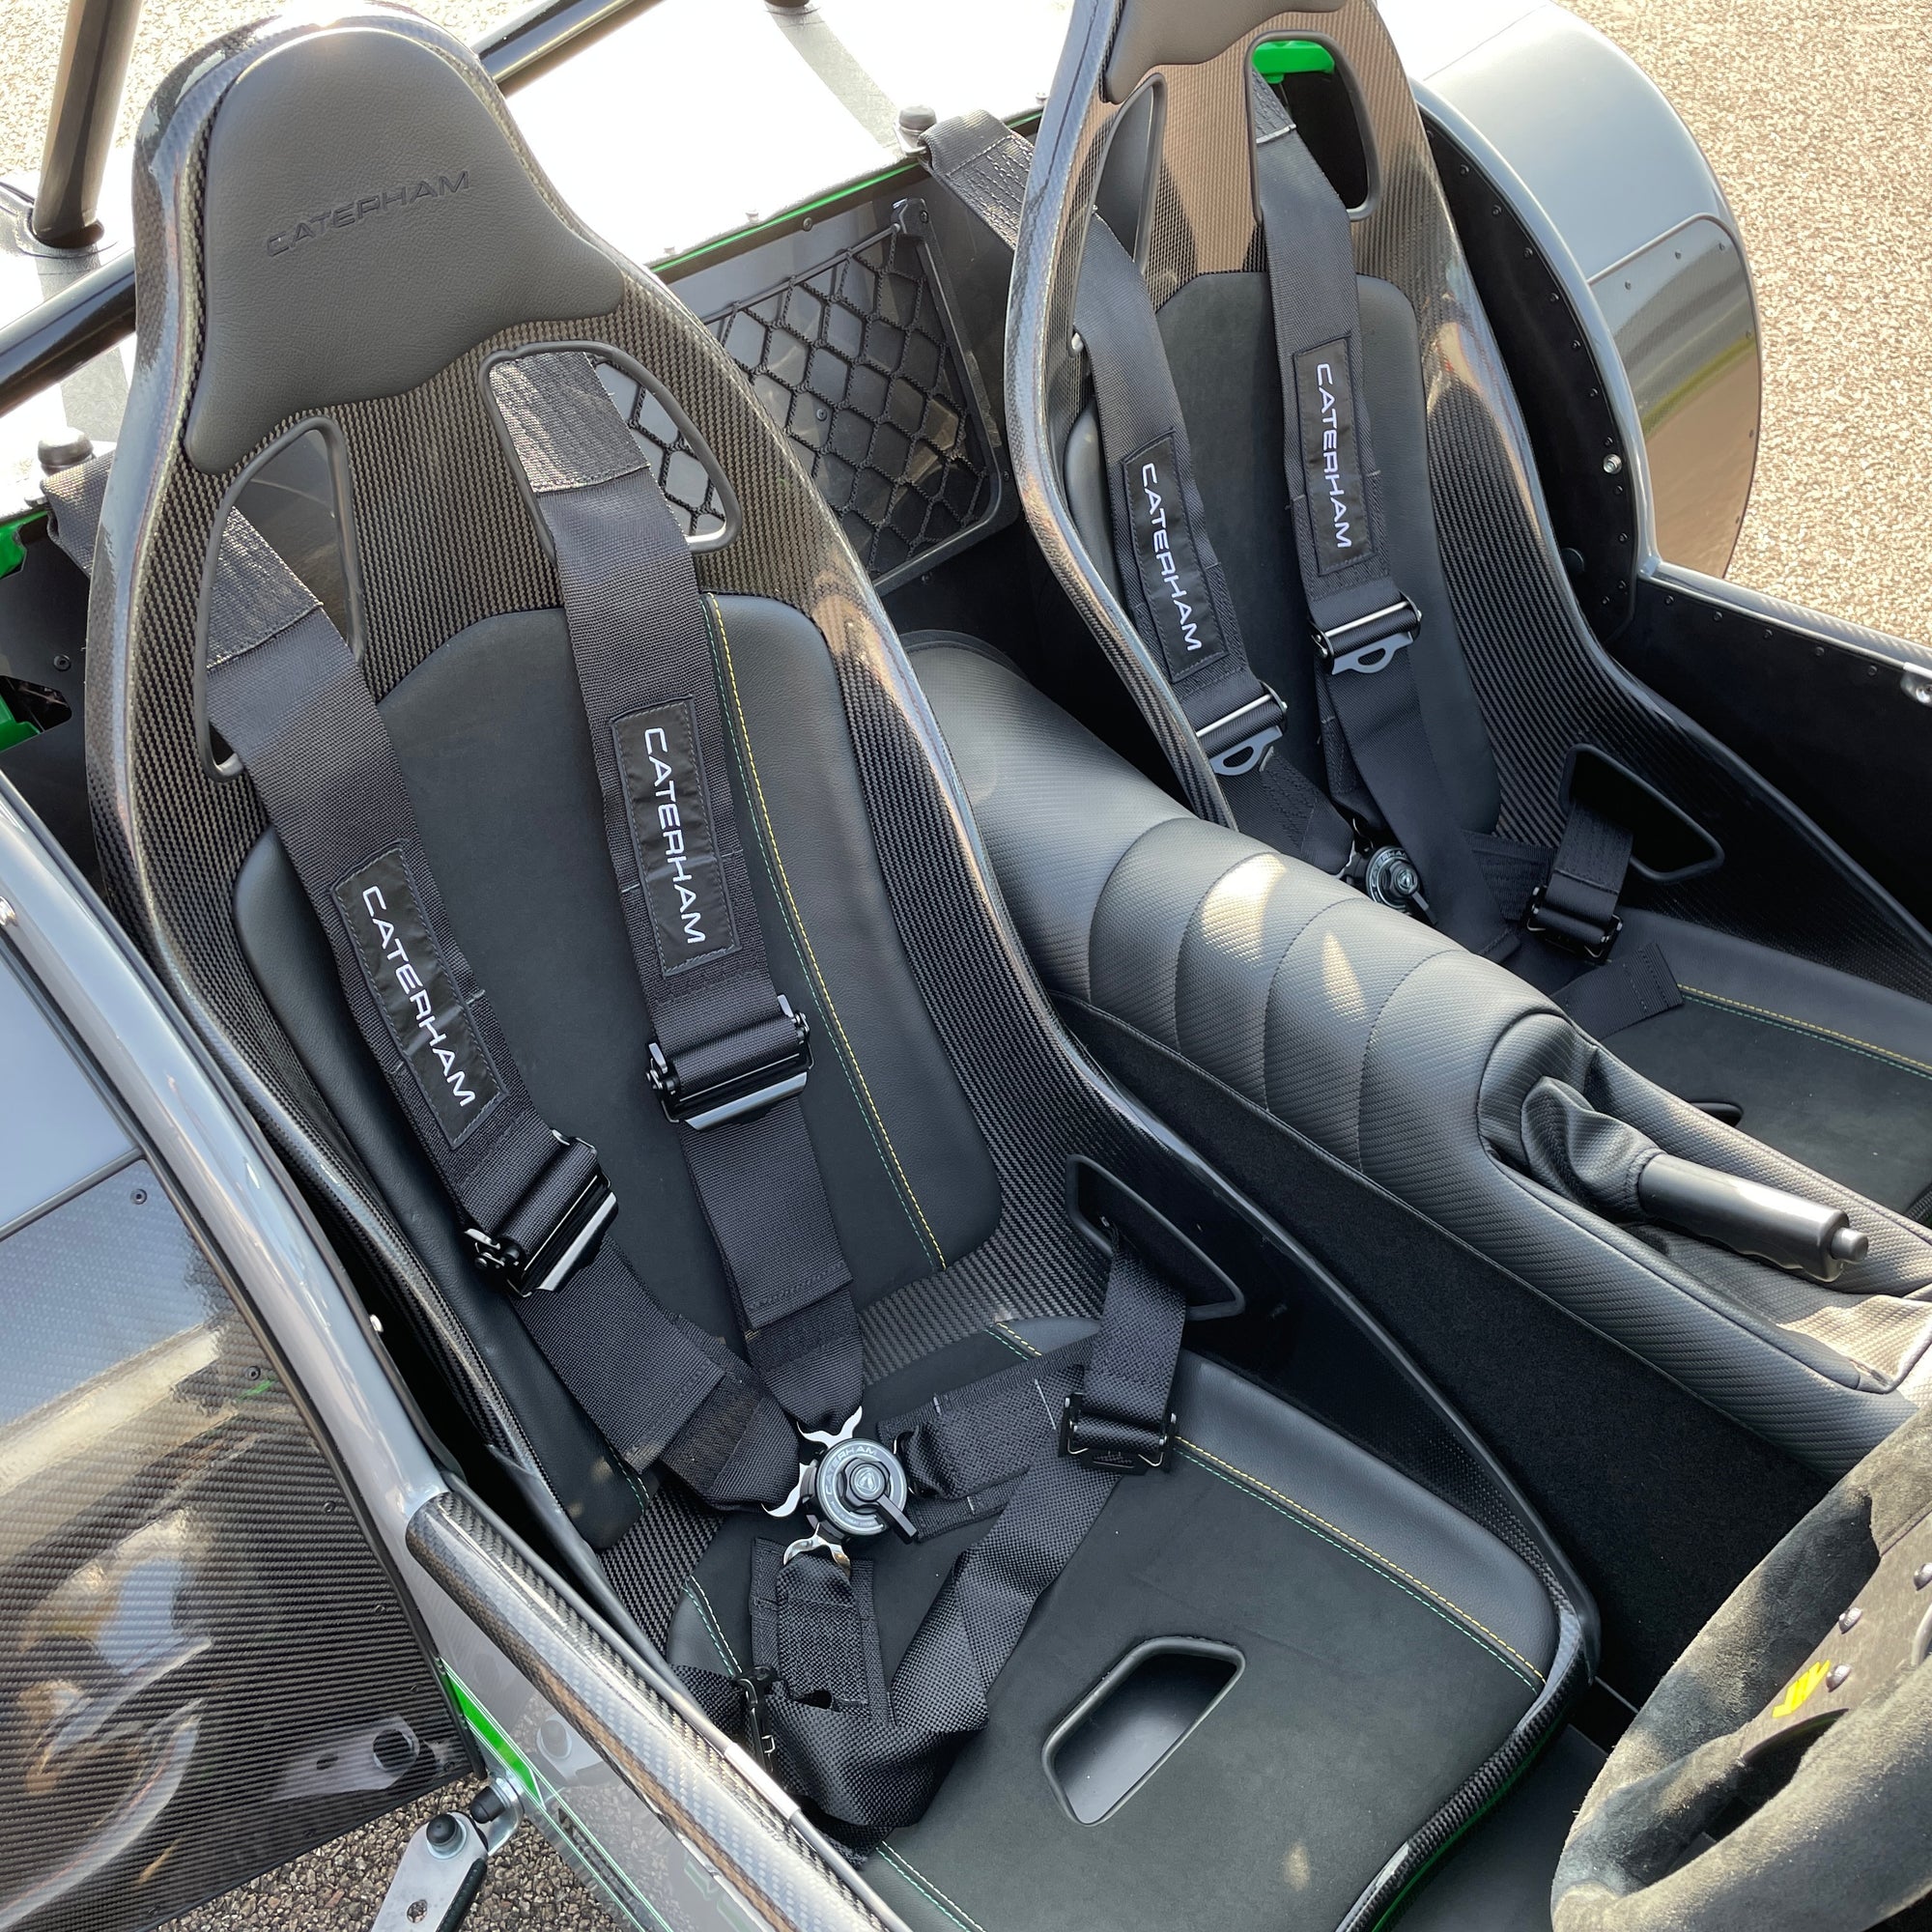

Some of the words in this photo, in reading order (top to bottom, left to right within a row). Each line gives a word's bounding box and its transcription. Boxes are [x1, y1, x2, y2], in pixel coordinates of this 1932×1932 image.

[267, 170, 469, 257] CATERHAM
[1317, 363, 1352, 548] CATERHAM
[1142, 463, 1203, 651] CATERHAM
[644, 727, 706, 944] CATERHAM
[362, 885, 476, 1107] CATERHAM
[825, 1445, 877, 1495] CATERHAM
